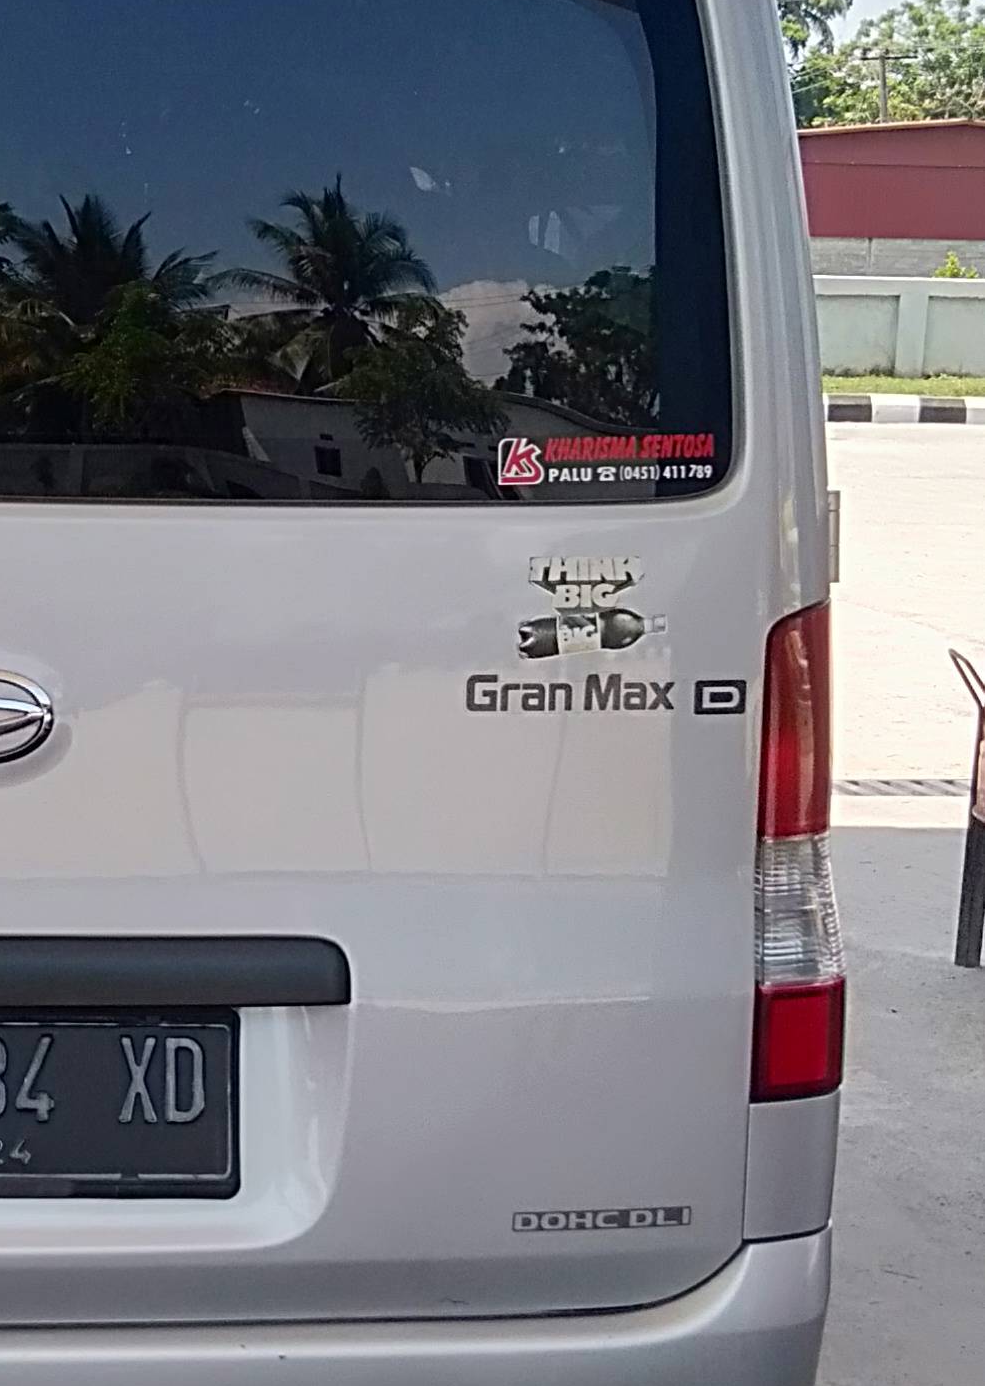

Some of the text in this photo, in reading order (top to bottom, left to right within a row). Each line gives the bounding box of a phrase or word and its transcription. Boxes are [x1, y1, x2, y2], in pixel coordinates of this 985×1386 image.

[544, 433, 714, 462] KHARISMA SENTOSA
[548, 467, 592, 482] PALU
[619, 465, 660, 481] (0451)
[529, 556, 643, 582] THINK
[554, 583, 617, 608] BIG
[466, 674, 573, 712] Gran
[584, 673, 676, 711] Max
[118, 1035, 205, 1123] XD
[514, 1208, 691, 1230] DOHC DLI
